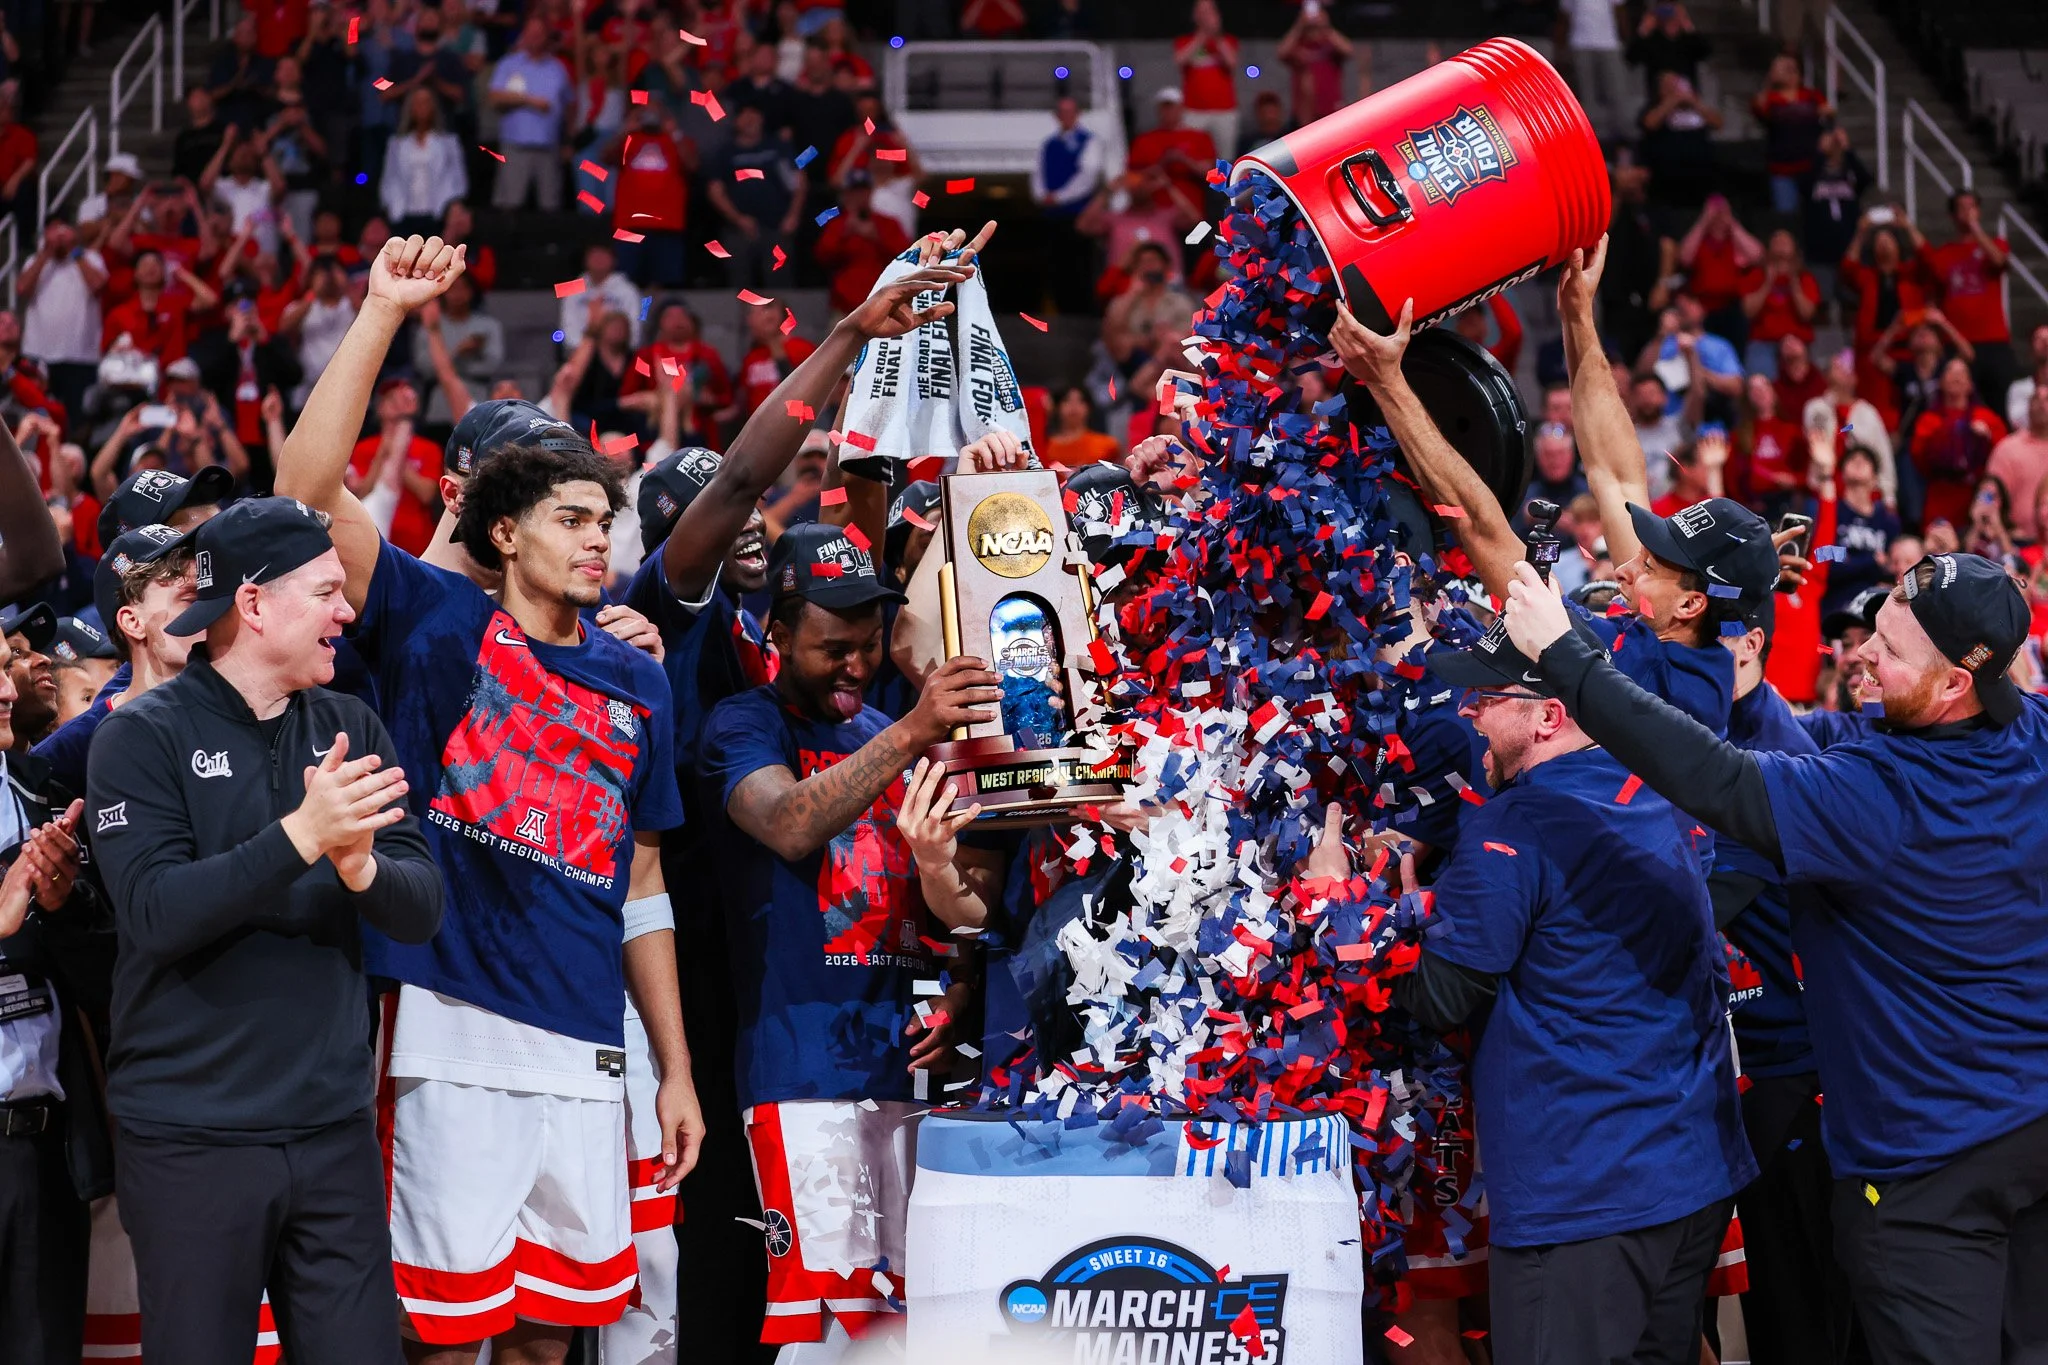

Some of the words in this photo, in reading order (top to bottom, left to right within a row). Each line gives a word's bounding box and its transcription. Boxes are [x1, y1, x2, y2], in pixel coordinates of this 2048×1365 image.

[1455, 115, 1499, 172] FOUR
[1475, 109, 1513, 163] INDIANAPOLIS
[1415, 133, 1461, 194] FINAL
[918, 341, 930, 373] ROAD
[970, 323, 993, 373] FINAL
[870, 375, 882, 400] THE
[876, 341, 888, 375] ROAD
[882, 346, 903, 397] FINAL
[931, 348, 951, 400] FINAL
[917, 373, 930, 400] THE
[676, 448, 704, 474] FINAL
[132, 470, 157, 493] FINAL
[816, 537, 853, 560] FINAL
[979, 530, 1053, 556] NCAA
[1009, 647, 1038, 657] MARCH
[1014, 655, 1052, 667] MADNESS
[191, 749, 233, 779] Cats
[980, 771, 1015, 790] WEST
[427, 809, 461, 832] 2026
[463, 824, 497, 846] EAST
[499, 839, 562, 873] REGIONAL
[564, 865, 614, 890] CHAMPS
[825, 954, 859, 967] 2026
[1728, 986, 1763, 1003] AMPS
[1089, 1249, 1143, 1272] SWEET
[1149, 1250, 1169, 1269] 16
[1011, 1303, 1047, 1315] NCAA
[1051, 1289, 1206, 1328] MARCH
[1074, 1328, 1280, 1365] MADNESS
